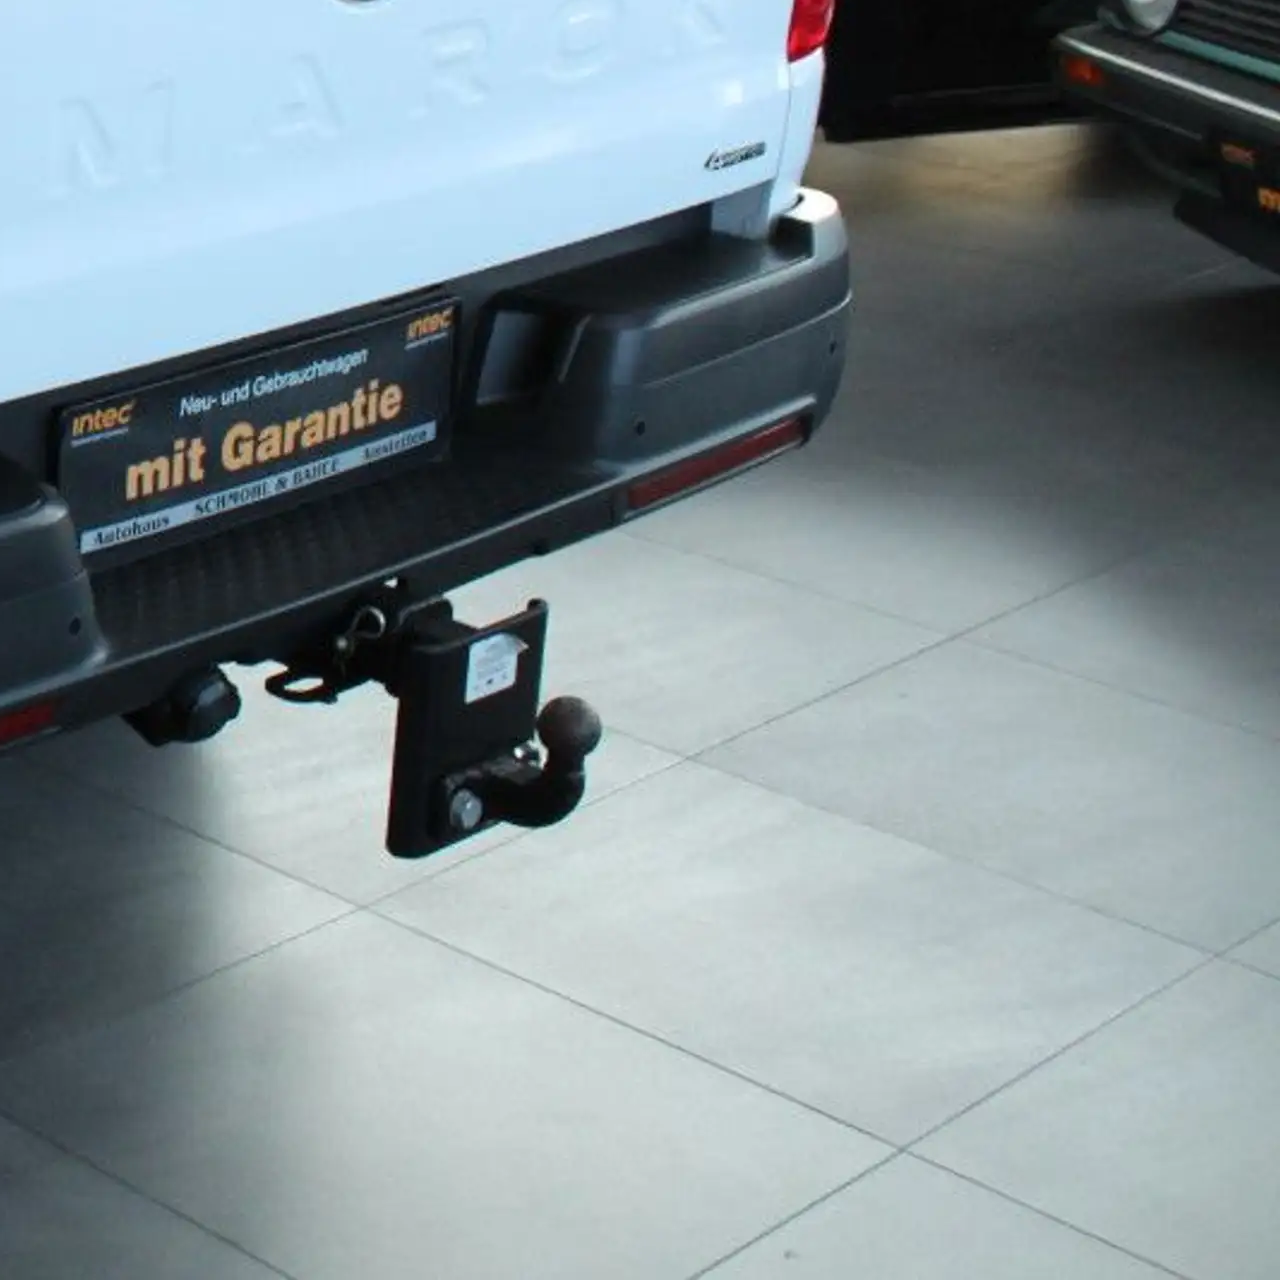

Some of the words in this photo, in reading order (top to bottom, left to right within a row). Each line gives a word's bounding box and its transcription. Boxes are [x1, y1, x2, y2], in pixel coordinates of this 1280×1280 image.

[179, 396, 219, 417] Neu-
[221, 383, 250, 405] und
[252, 348, 369, 398] Gebrauchtwagen
[125, 437, 207, 502] mit
[221, 377, 404, 471] Garantie
[93, 516, 171, 546] Autohaus
